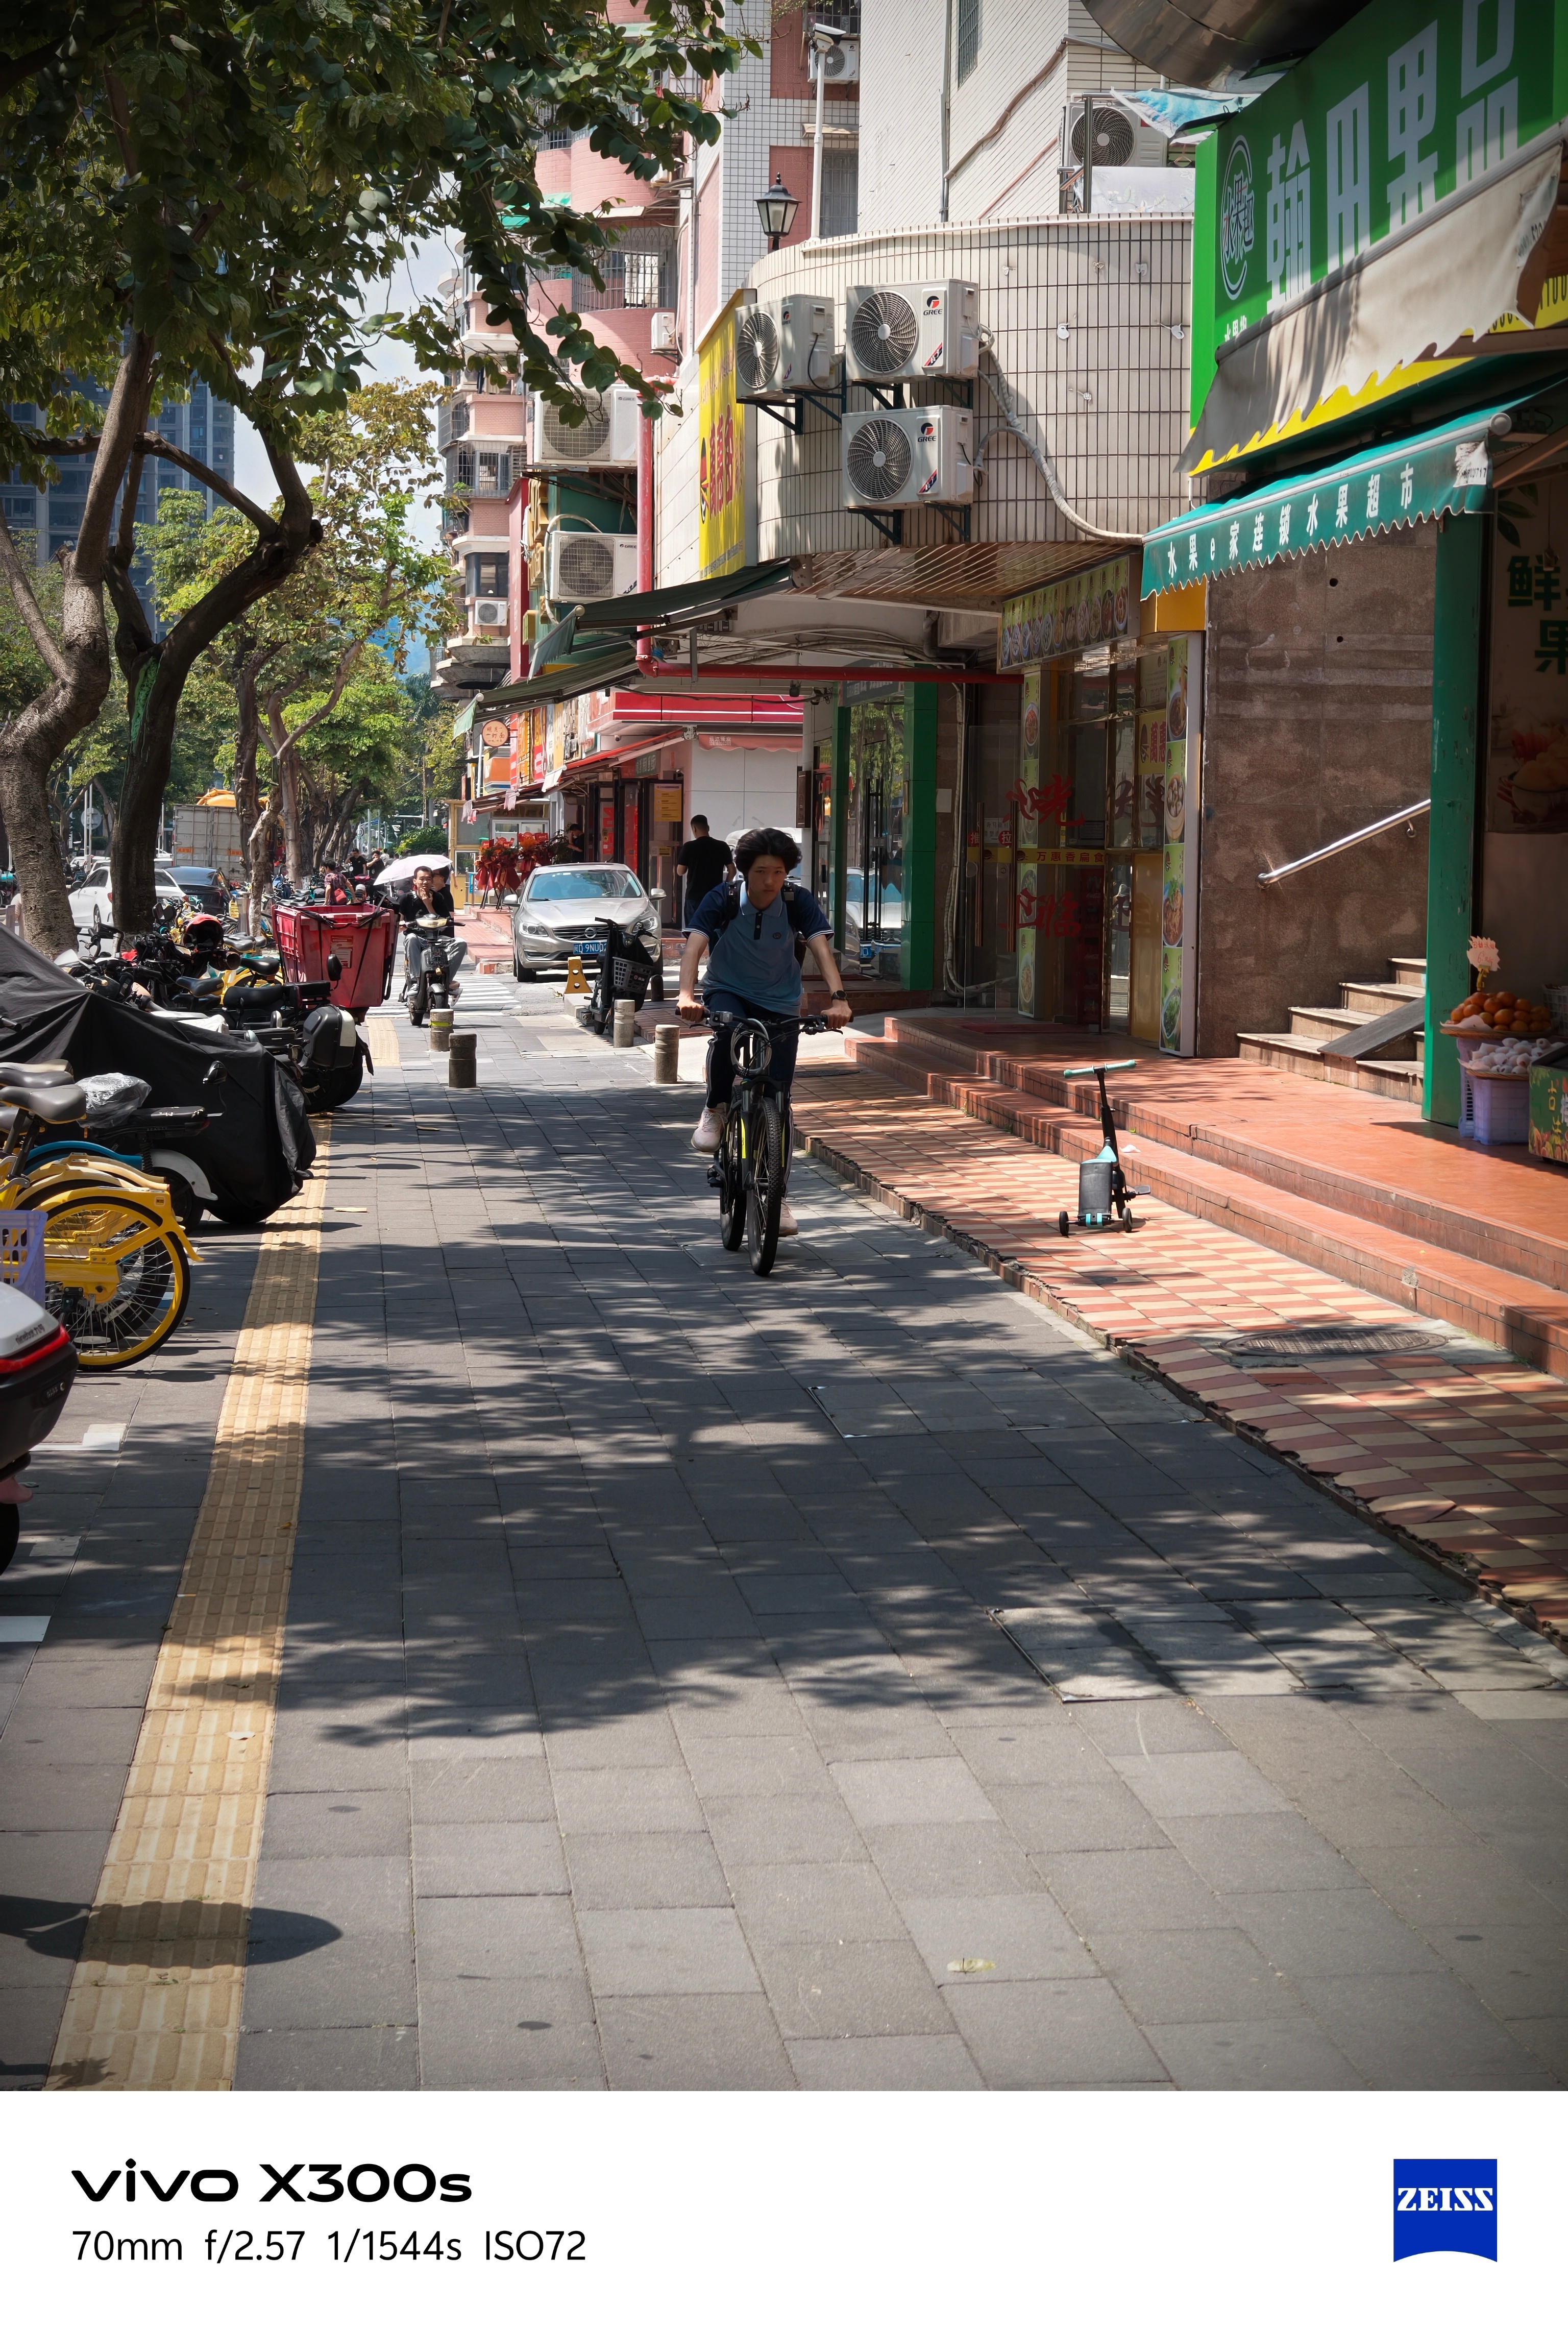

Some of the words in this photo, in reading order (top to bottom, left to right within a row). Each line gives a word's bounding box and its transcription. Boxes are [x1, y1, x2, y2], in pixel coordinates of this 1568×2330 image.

[1507, 555, 1568, 611] 鲜
[1001, 831, 1012, 844] 拉
[1037, 852, 1104, 863] 万惠香扁食
